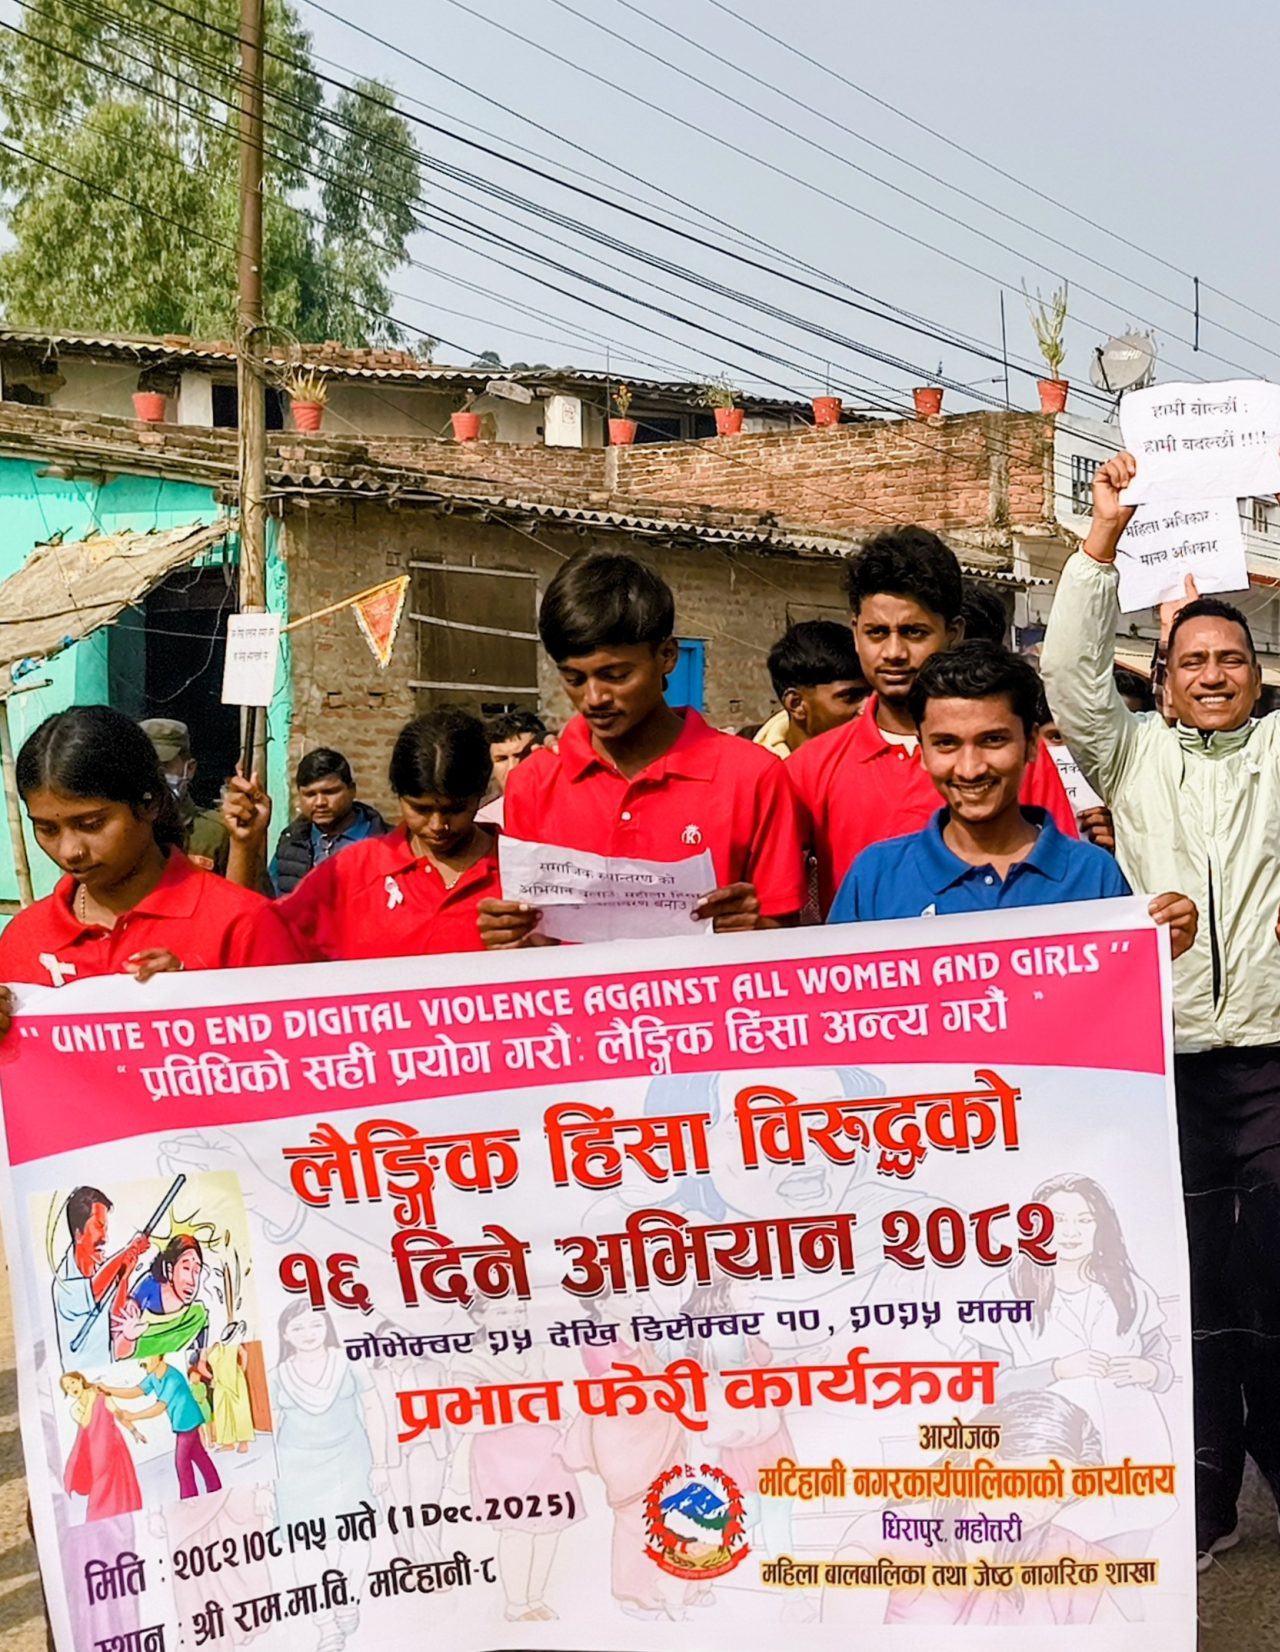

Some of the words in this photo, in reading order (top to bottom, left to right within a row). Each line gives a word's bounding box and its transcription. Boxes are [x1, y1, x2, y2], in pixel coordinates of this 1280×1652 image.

[52, 1020, 145, 1052] UNITE
[151, 1018, 197, 1048] TO
[205, 1013, 273, 1045] END
[283, 1000, 412, 1040] DIGITAL
[419, 988, 574, 1026] VIOLENCE
[584, 975, 720, 1016] AGAINST
[732, 970, 789, 1003] ALL
[797, 958, 921, 996] WOMEN
[932, 951, 1001, 987] AND
[1010, 942, 1100, 977] GIRLS
[139, 1049, 289, 1102] प्रविधिको
[300, 1041, 376, 1091] सही
[388, 1033, 492, 1087] प्रयोग
[725, 1006, 809, 1054] हिंसा
[820, 1003, 929, 1045] अन्त्य
[543, 1101, 712, 1191] हिंसा
[278, 1251, 375, 1316] १६
[391, 1224, 533, 1310] दिने
[554, 1209, 858, 1299] अभियान
[881, 1201, 1058, 1272] २०८२
[343, 1331, 476, 1361] नोभेम्बर
[547, 1318, 620, 1348] देखि
[630, 1311, 765, 1344] डिसेम्बर
[957, 1299, 1036, 1324] सम्म
[395, 1380, 564, 1443] प्रभात
[573, 1357, 710, 1432] फेरी
[719, 1345, 1000, 1410] कार्यक्रम
[918, 1416, 1002, 1451] आयोजक
[757, 1456, 848, 1500] मटिहानी
[852, 1458, 1065, 1500] नगरकार्यपालिकाको
[1071, 1457, 1176, 1498] कार्यालय
[84, 1550, 147, 1607] मिति
[335, 1500, 377, 1542] गते
[954, 1512, 1023, 1544] महोत्तरी
[761, 1556, 819, 1586] महिला
[824, 1557, 927, 1586] बालबालिका
[932, 1564, 968, 1586] तथा
[1020, 1556, 1100, 1586] नागरिक
[1105, 1561, 1157, 1586] शाखा
[191, 1599, 225, 1646] श्री
